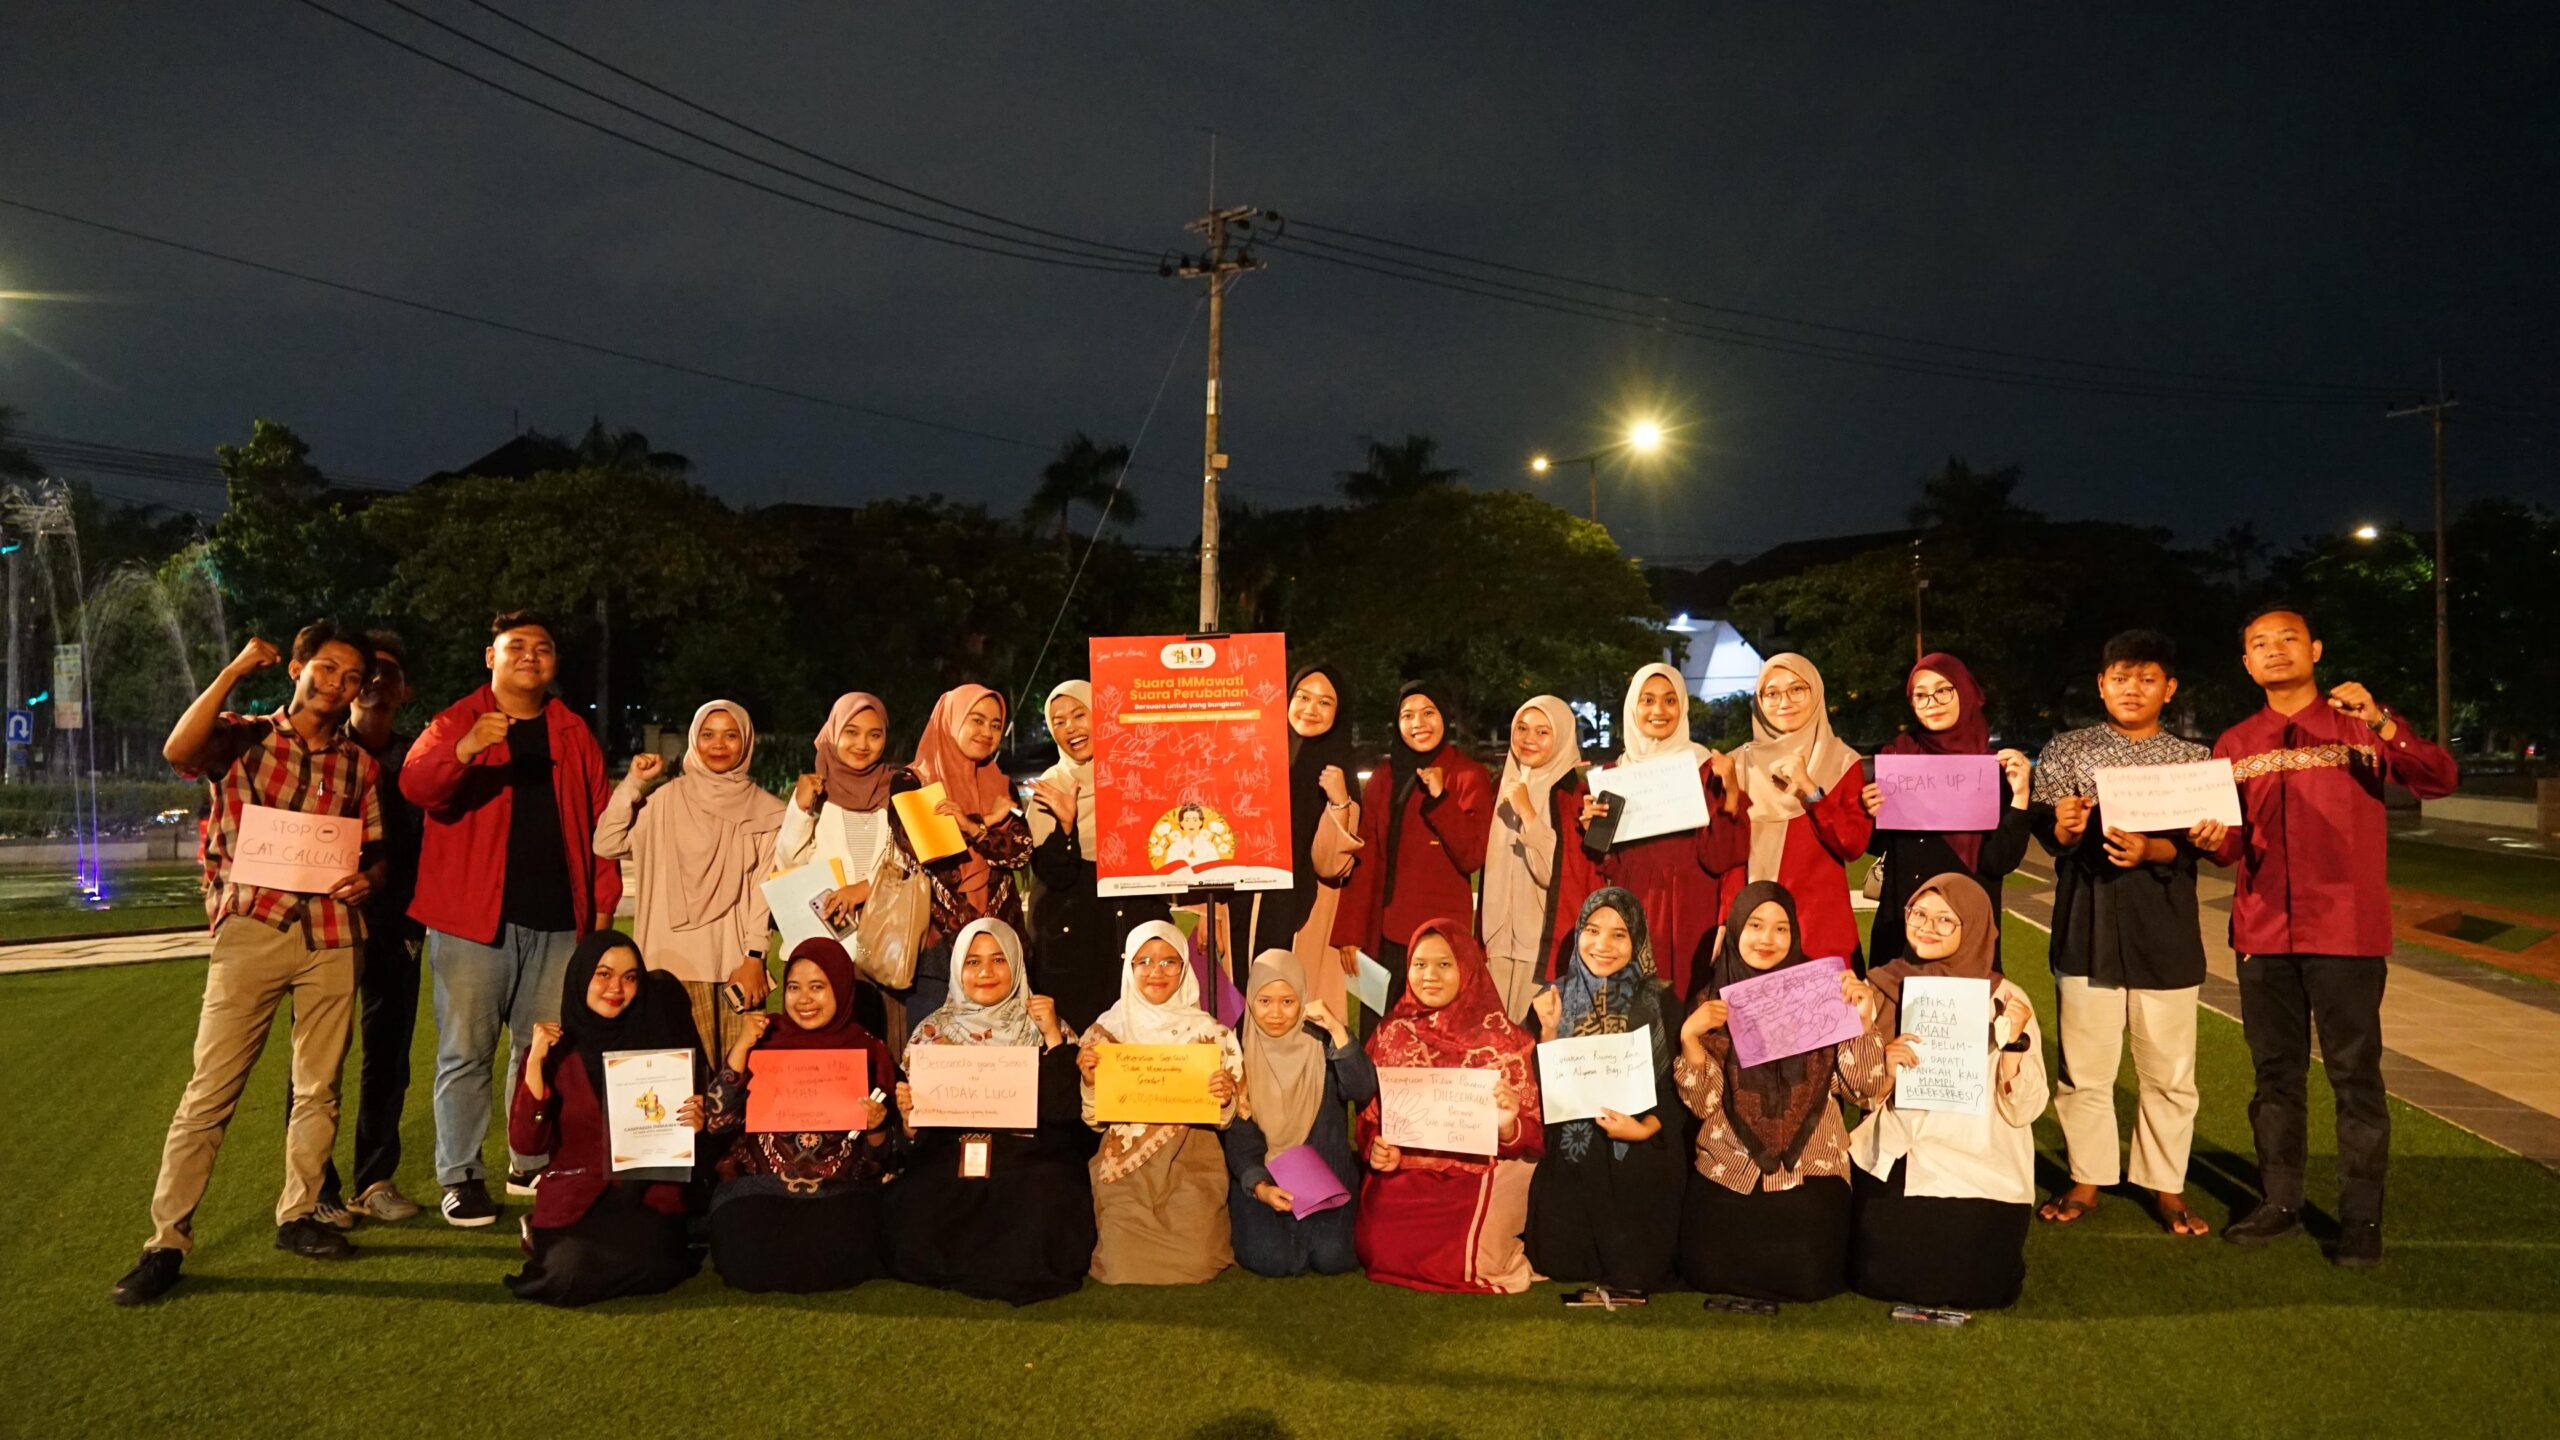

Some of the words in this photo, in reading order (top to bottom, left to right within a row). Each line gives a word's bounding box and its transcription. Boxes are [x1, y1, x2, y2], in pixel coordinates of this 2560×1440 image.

[1133, 678, 1174, 689] Suara
[1177, 674, 1244, 687] IMMawati
[1129, 690, 1171, 700] Suara
[1174, 688, 1249, 699] Perubahan
[1885, 773, 1936, 796] SPEAK
[1946, 774, 1967, 792] UP
[271, 819, 312, 837] STOP
[241, 838, 274, 856] CAT
[281, 845, 357, 868] CALLING
[1919, 1009, 1957, 1025] RASA
[1914, 1024, 1951, 1038] AMAN
[1930, 1055, 1964, 1067] DAPATI
[1958, 1069, 1979, 1081] KAU
[929, 1083, 979, 1099] TIDAK
[984, 1087, 1017, 1099] LUCU
